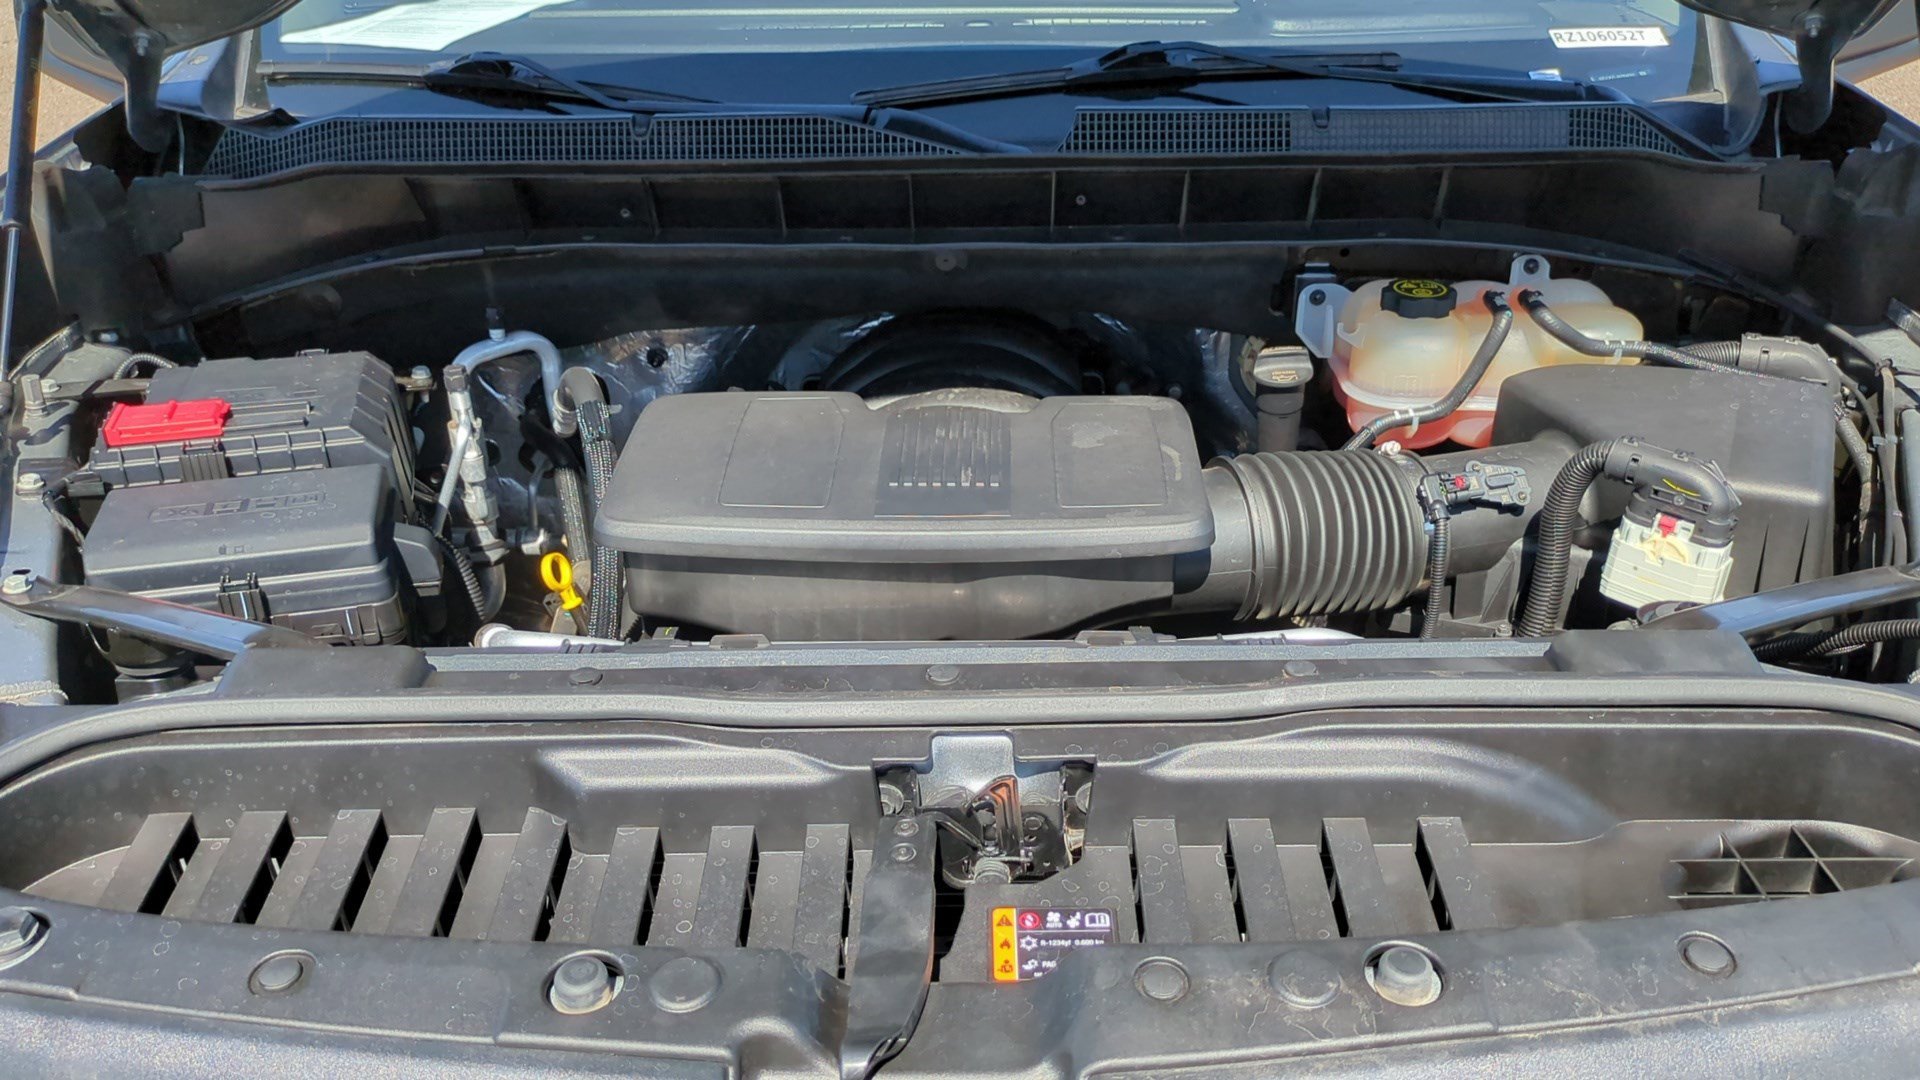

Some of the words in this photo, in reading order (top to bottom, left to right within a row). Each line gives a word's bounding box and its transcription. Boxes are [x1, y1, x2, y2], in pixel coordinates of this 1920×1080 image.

[1553, 30, 1645, 43] RZ106052T
[1040, 939, 1071, 947] R-1234yf
[1042, 960, 1057, 968] PAG
